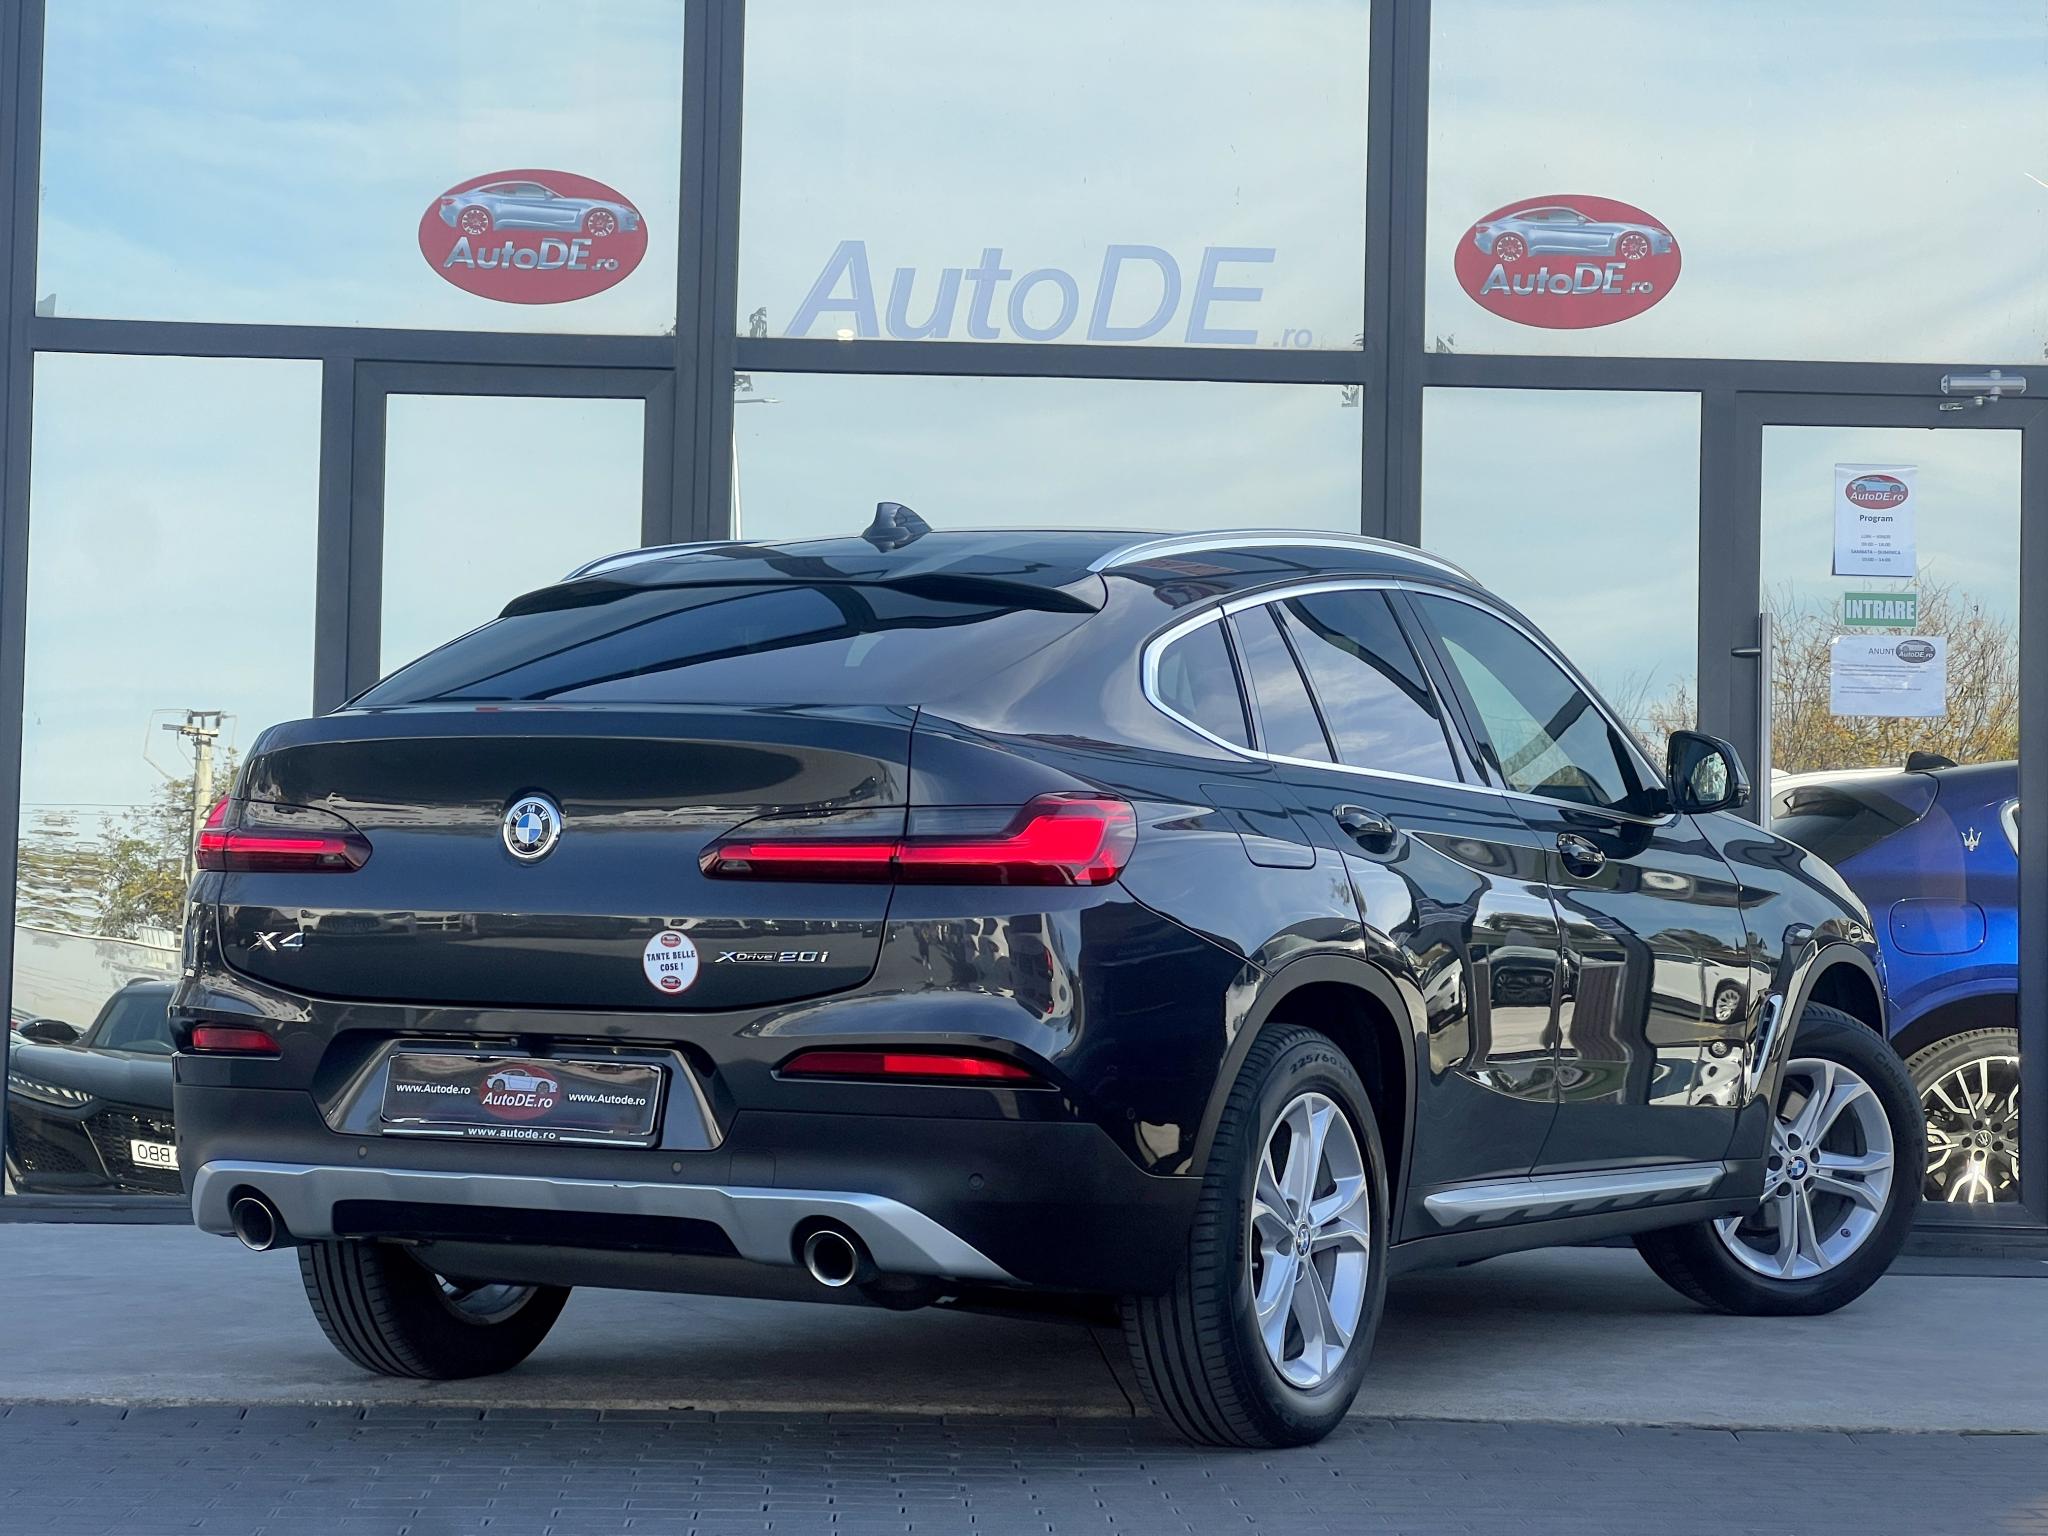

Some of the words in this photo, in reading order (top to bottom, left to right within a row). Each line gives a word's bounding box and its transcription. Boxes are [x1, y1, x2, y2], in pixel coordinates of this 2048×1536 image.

[1850, 492, 1904, 501] AutoDE.ro
[1859, 514, 1893, 523] Program
[1846, 600, 1915, 619] INTRARE
[513, 804, 549, 821] BMW
[247, 931, 305, 952] X4
[646, 952, 670, 961] TANTE
[672, 950, 696, 960] BELLE
[660, 962, 679, 971] COSE
[396, 1083, 471, 1095] www.Autode.ro
[482, 1092, 553, 1108] AutoDE.ro
[568, 1092, 646, 1106] www.Autode.ro
[468, 1126, 556, 1140] www.autode.ro
